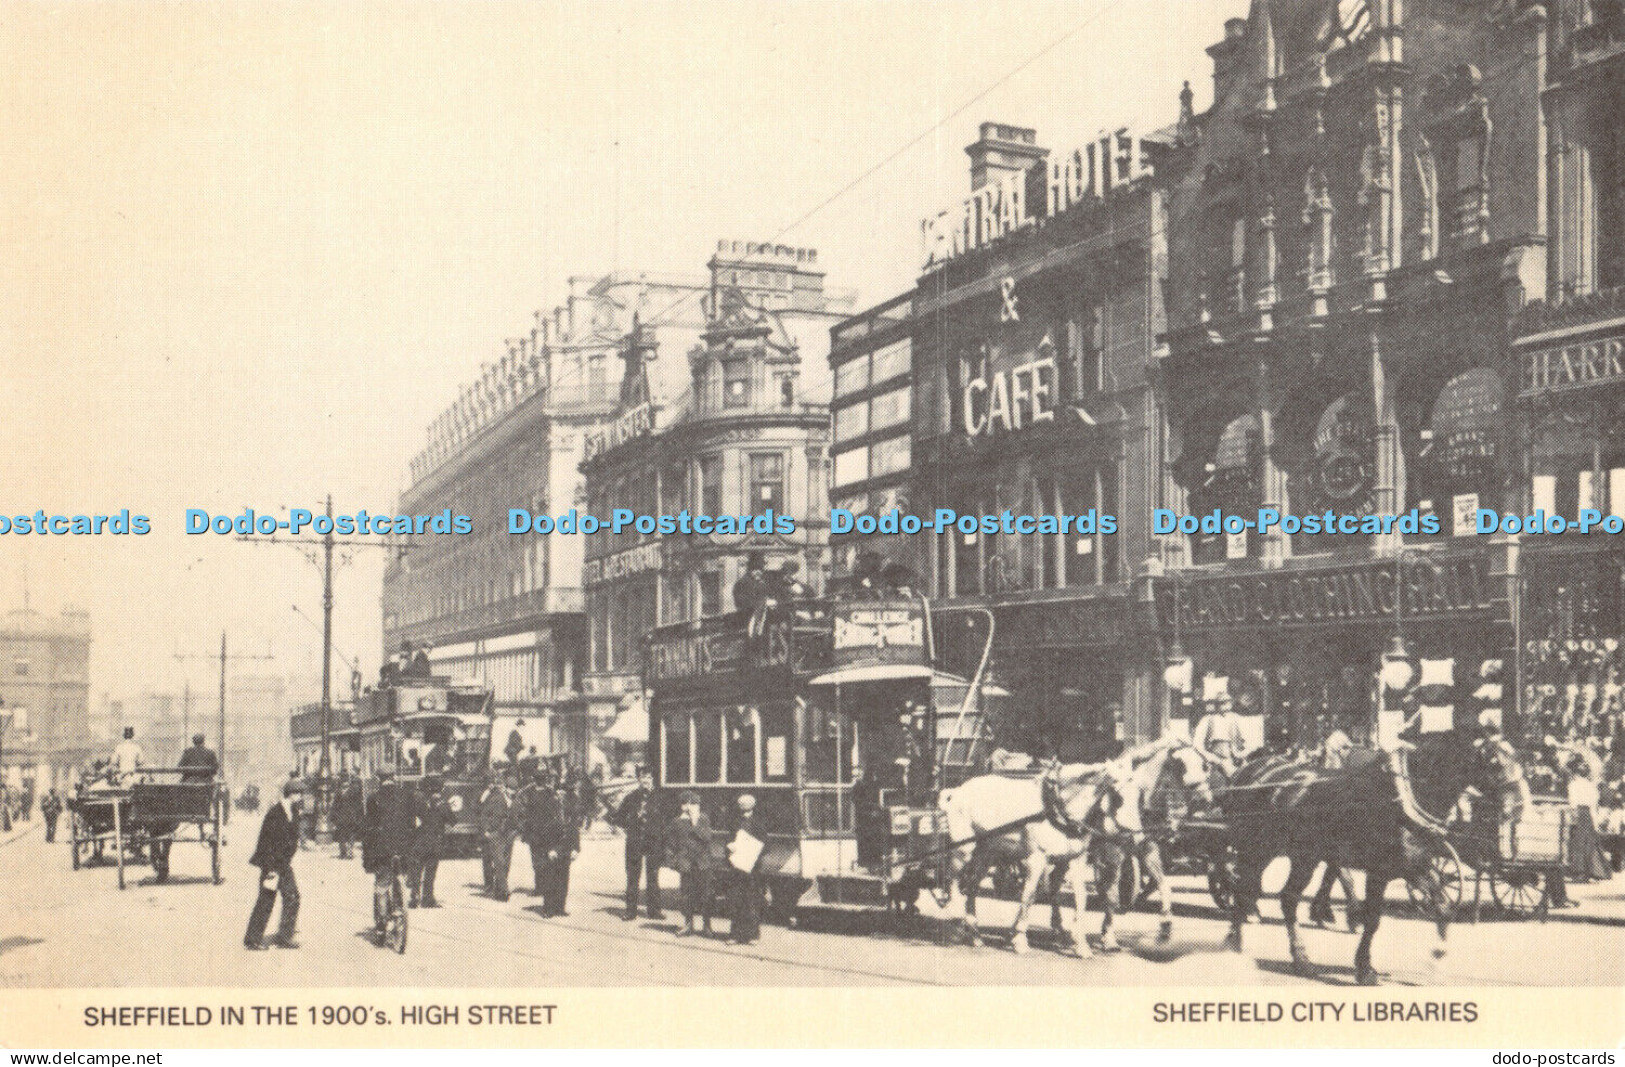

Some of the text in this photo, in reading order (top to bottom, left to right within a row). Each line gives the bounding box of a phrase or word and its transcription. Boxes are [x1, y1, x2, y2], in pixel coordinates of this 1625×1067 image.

[1046, 128, 1154, 217] HOTEL
[999, 275, 1020, 323] &
[1163, 563, 1491, 625] GRAND CLOTHING HALL
